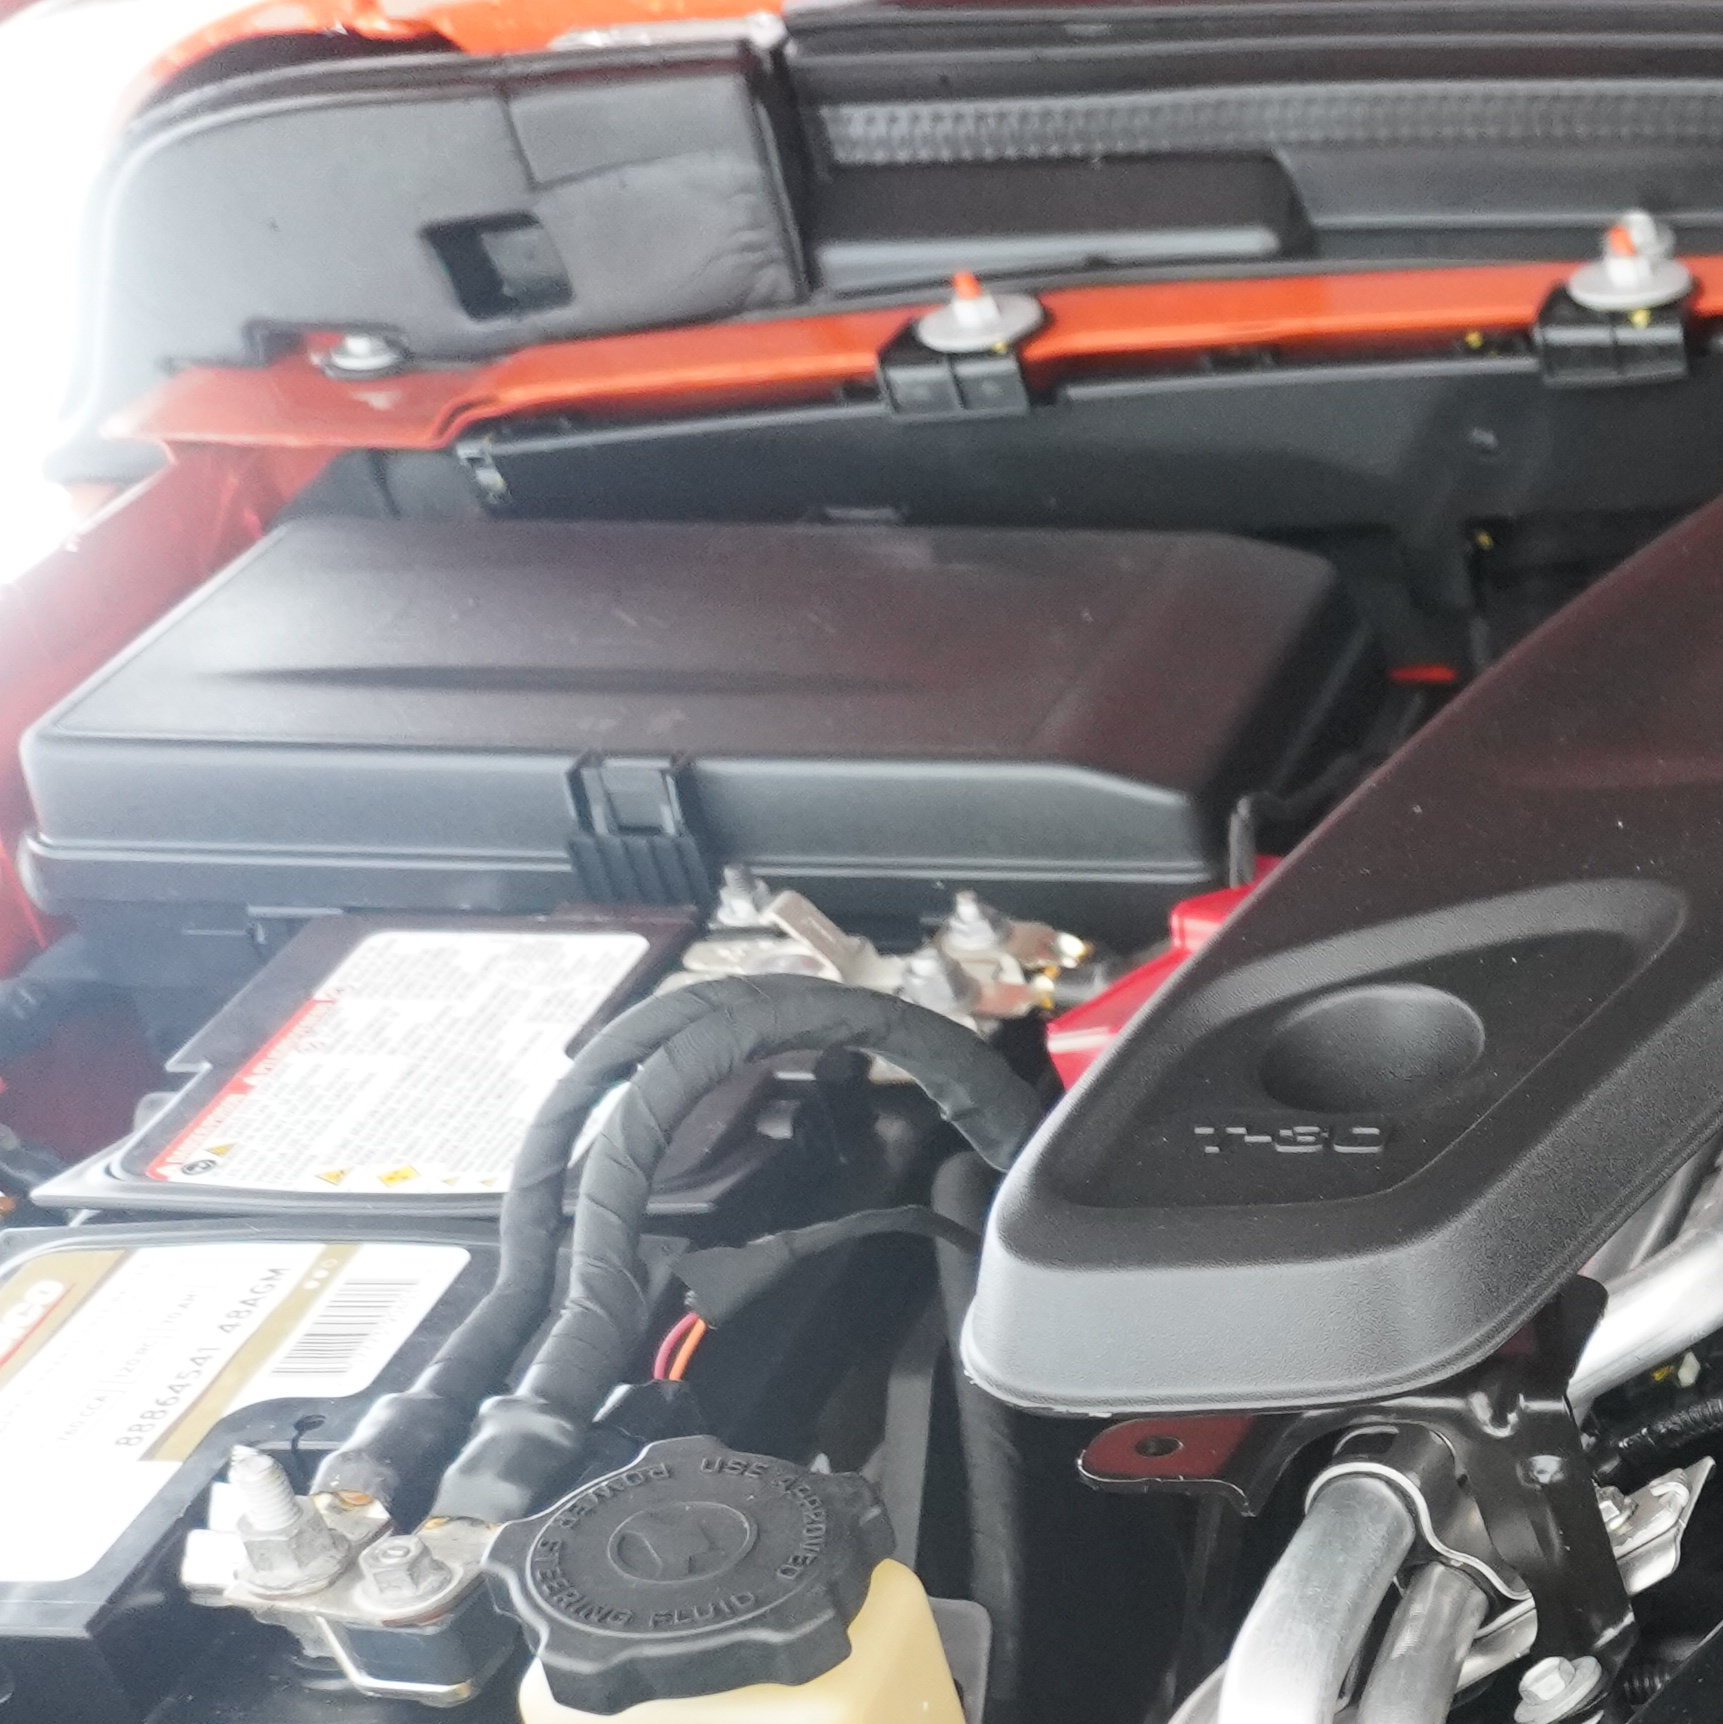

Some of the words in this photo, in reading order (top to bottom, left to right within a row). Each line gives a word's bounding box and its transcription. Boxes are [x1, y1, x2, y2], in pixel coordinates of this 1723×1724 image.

[211, 1266, 292, 1334] 48AGM
[558, 1462, 672, 1530] POWER
[699, 1456, 769, 1477] USE
[769, 1470, 828, 1582] APPROVED
[535, 1536, 634, 1628] STEERING
[649, 1590, 757, 1630] FLUID
